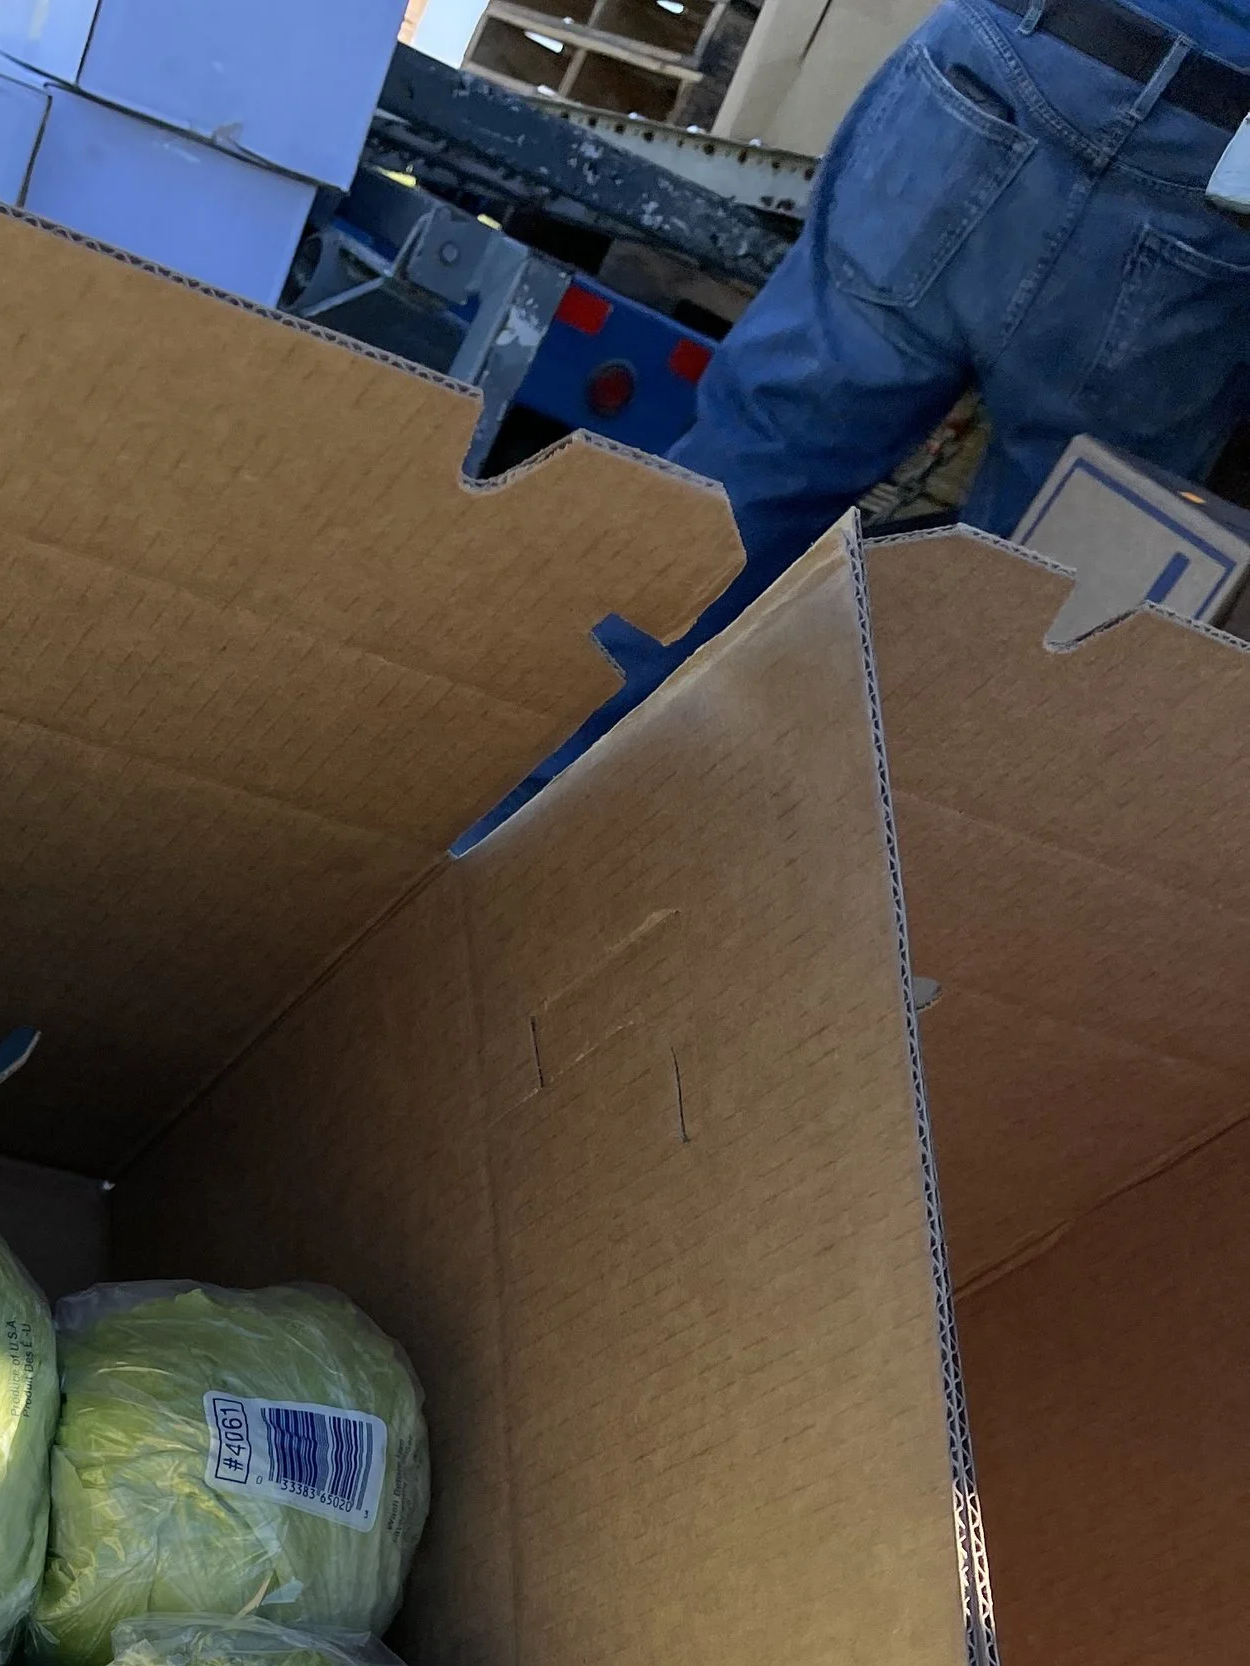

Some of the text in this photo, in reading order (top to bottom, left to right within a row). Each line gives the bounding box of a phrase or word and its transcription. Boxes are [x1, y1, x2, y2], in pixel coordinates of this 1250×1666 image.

[11, 1355, 20, 1366] of
[24, 1350, 34, 1372] Des
[10, 1369, 20, 1417] Produce
[220, 1407, 246, 1471] #4061
[256, 1476, 369, 1519] 0 33383 65020 3
